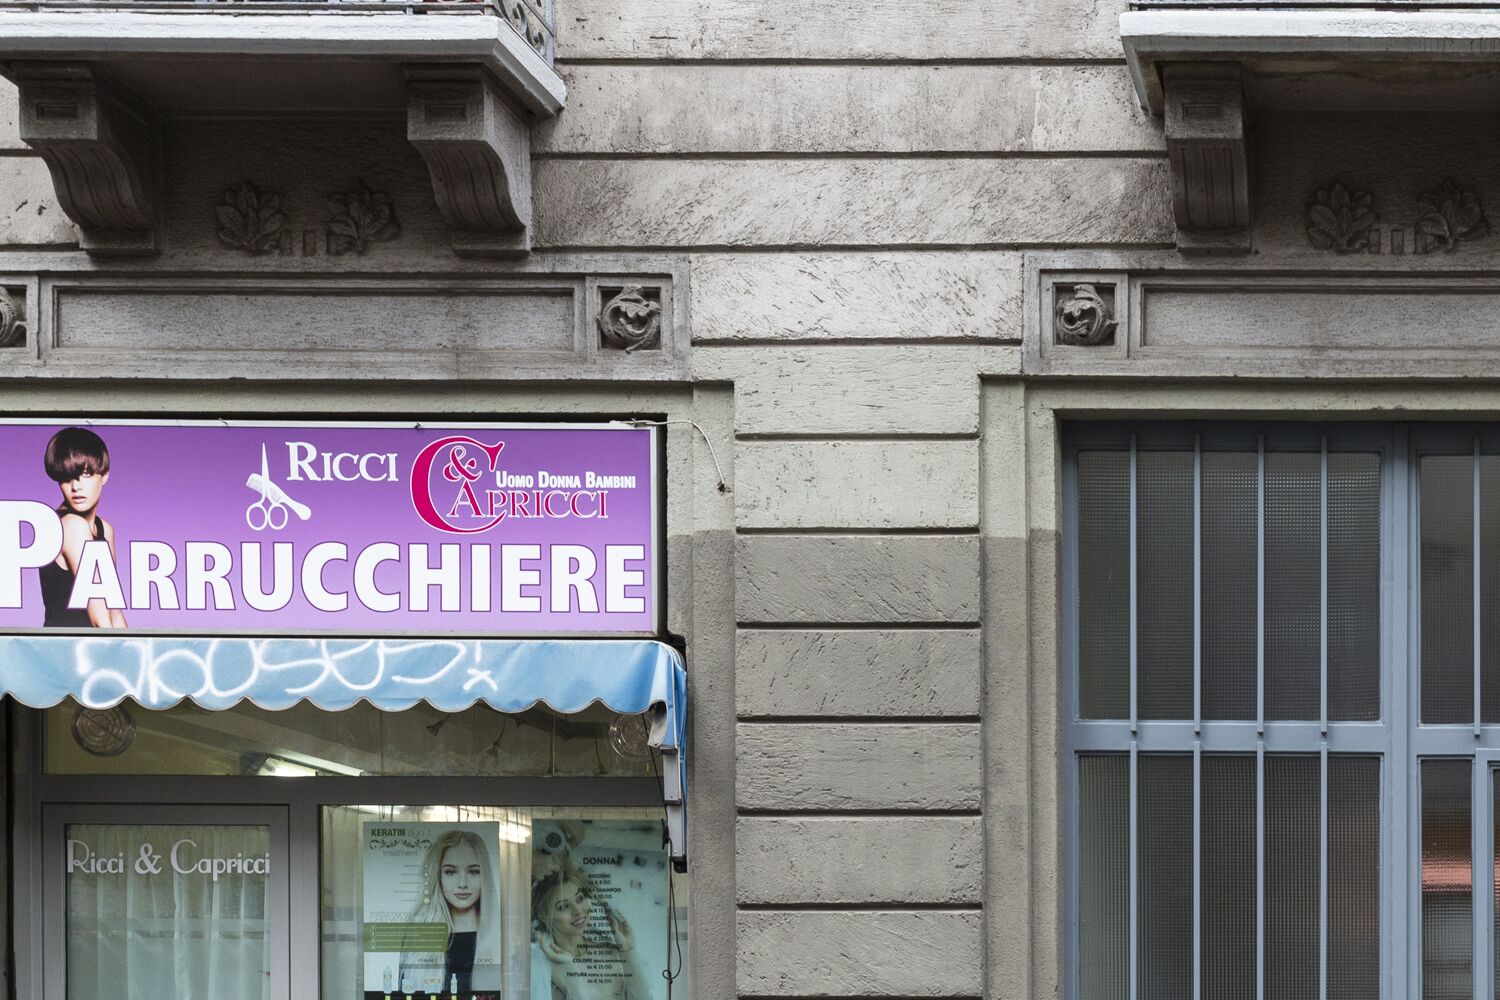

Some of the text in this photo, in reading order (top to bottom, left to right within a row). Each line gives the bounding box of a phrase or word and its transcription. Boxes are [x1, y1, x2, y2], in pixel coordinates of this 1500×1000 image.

[285, 441, 399, 482] RICCI
[410, 435, 609, 534] CAPRICCI
[495, 470, 636, 489] UOMO DONNA BAMBINI
[0, 500, 646, 613] PARRUCCHIERE
[370, 828, 406, 837] KERATIN
[67, 839, 270, 881] Ricci & Capricci
[583, 856, 616, 865] DONNA
